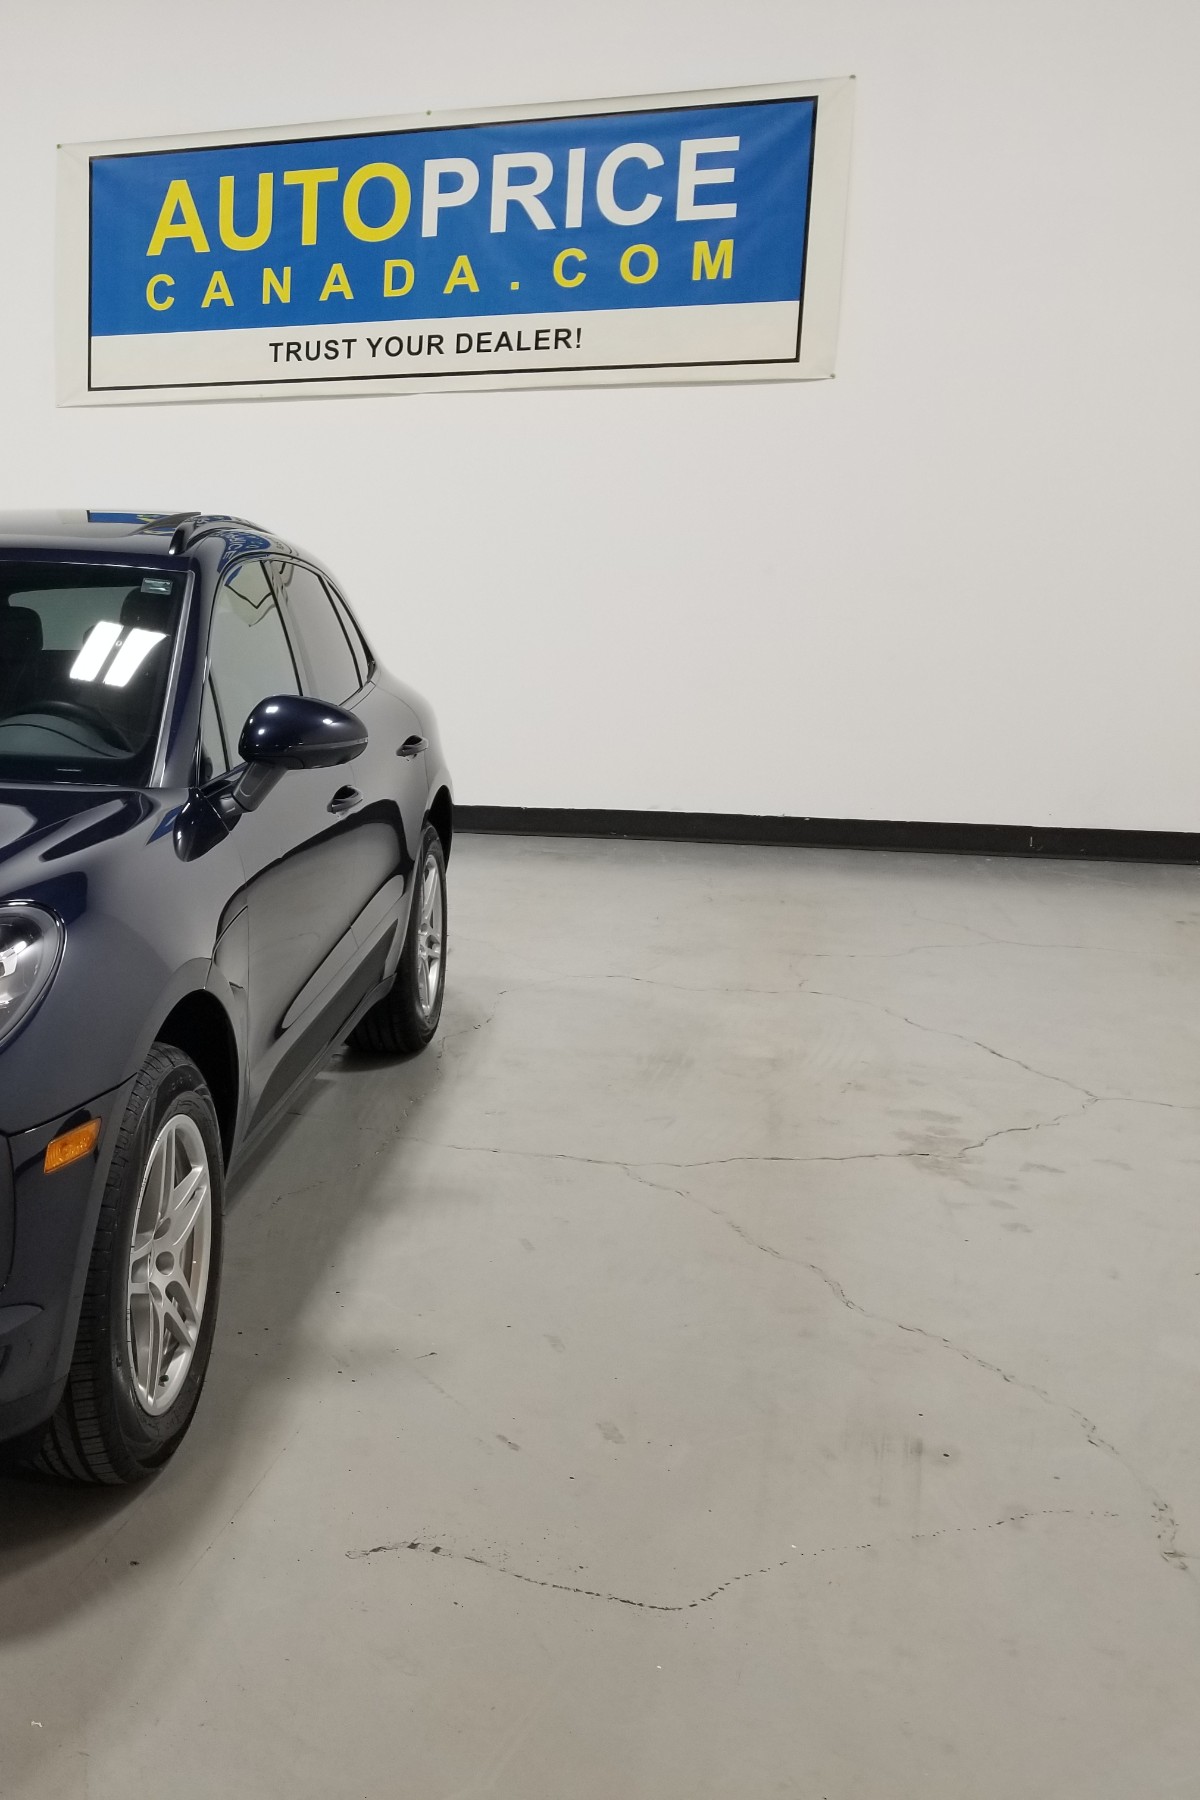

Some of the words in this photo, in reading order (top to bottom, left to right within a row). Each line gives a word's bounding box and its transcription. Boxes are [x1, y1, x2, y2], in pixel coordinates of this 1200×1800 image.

[145, 136, 741, 257] AUTOPRICE
[145, 239, 735, 312] CANADA.COM
[268, 339, 357, 363] TRUST
[367, 335, 445, 358] YOUR
[456, 327, 583, 354] DEALER!
